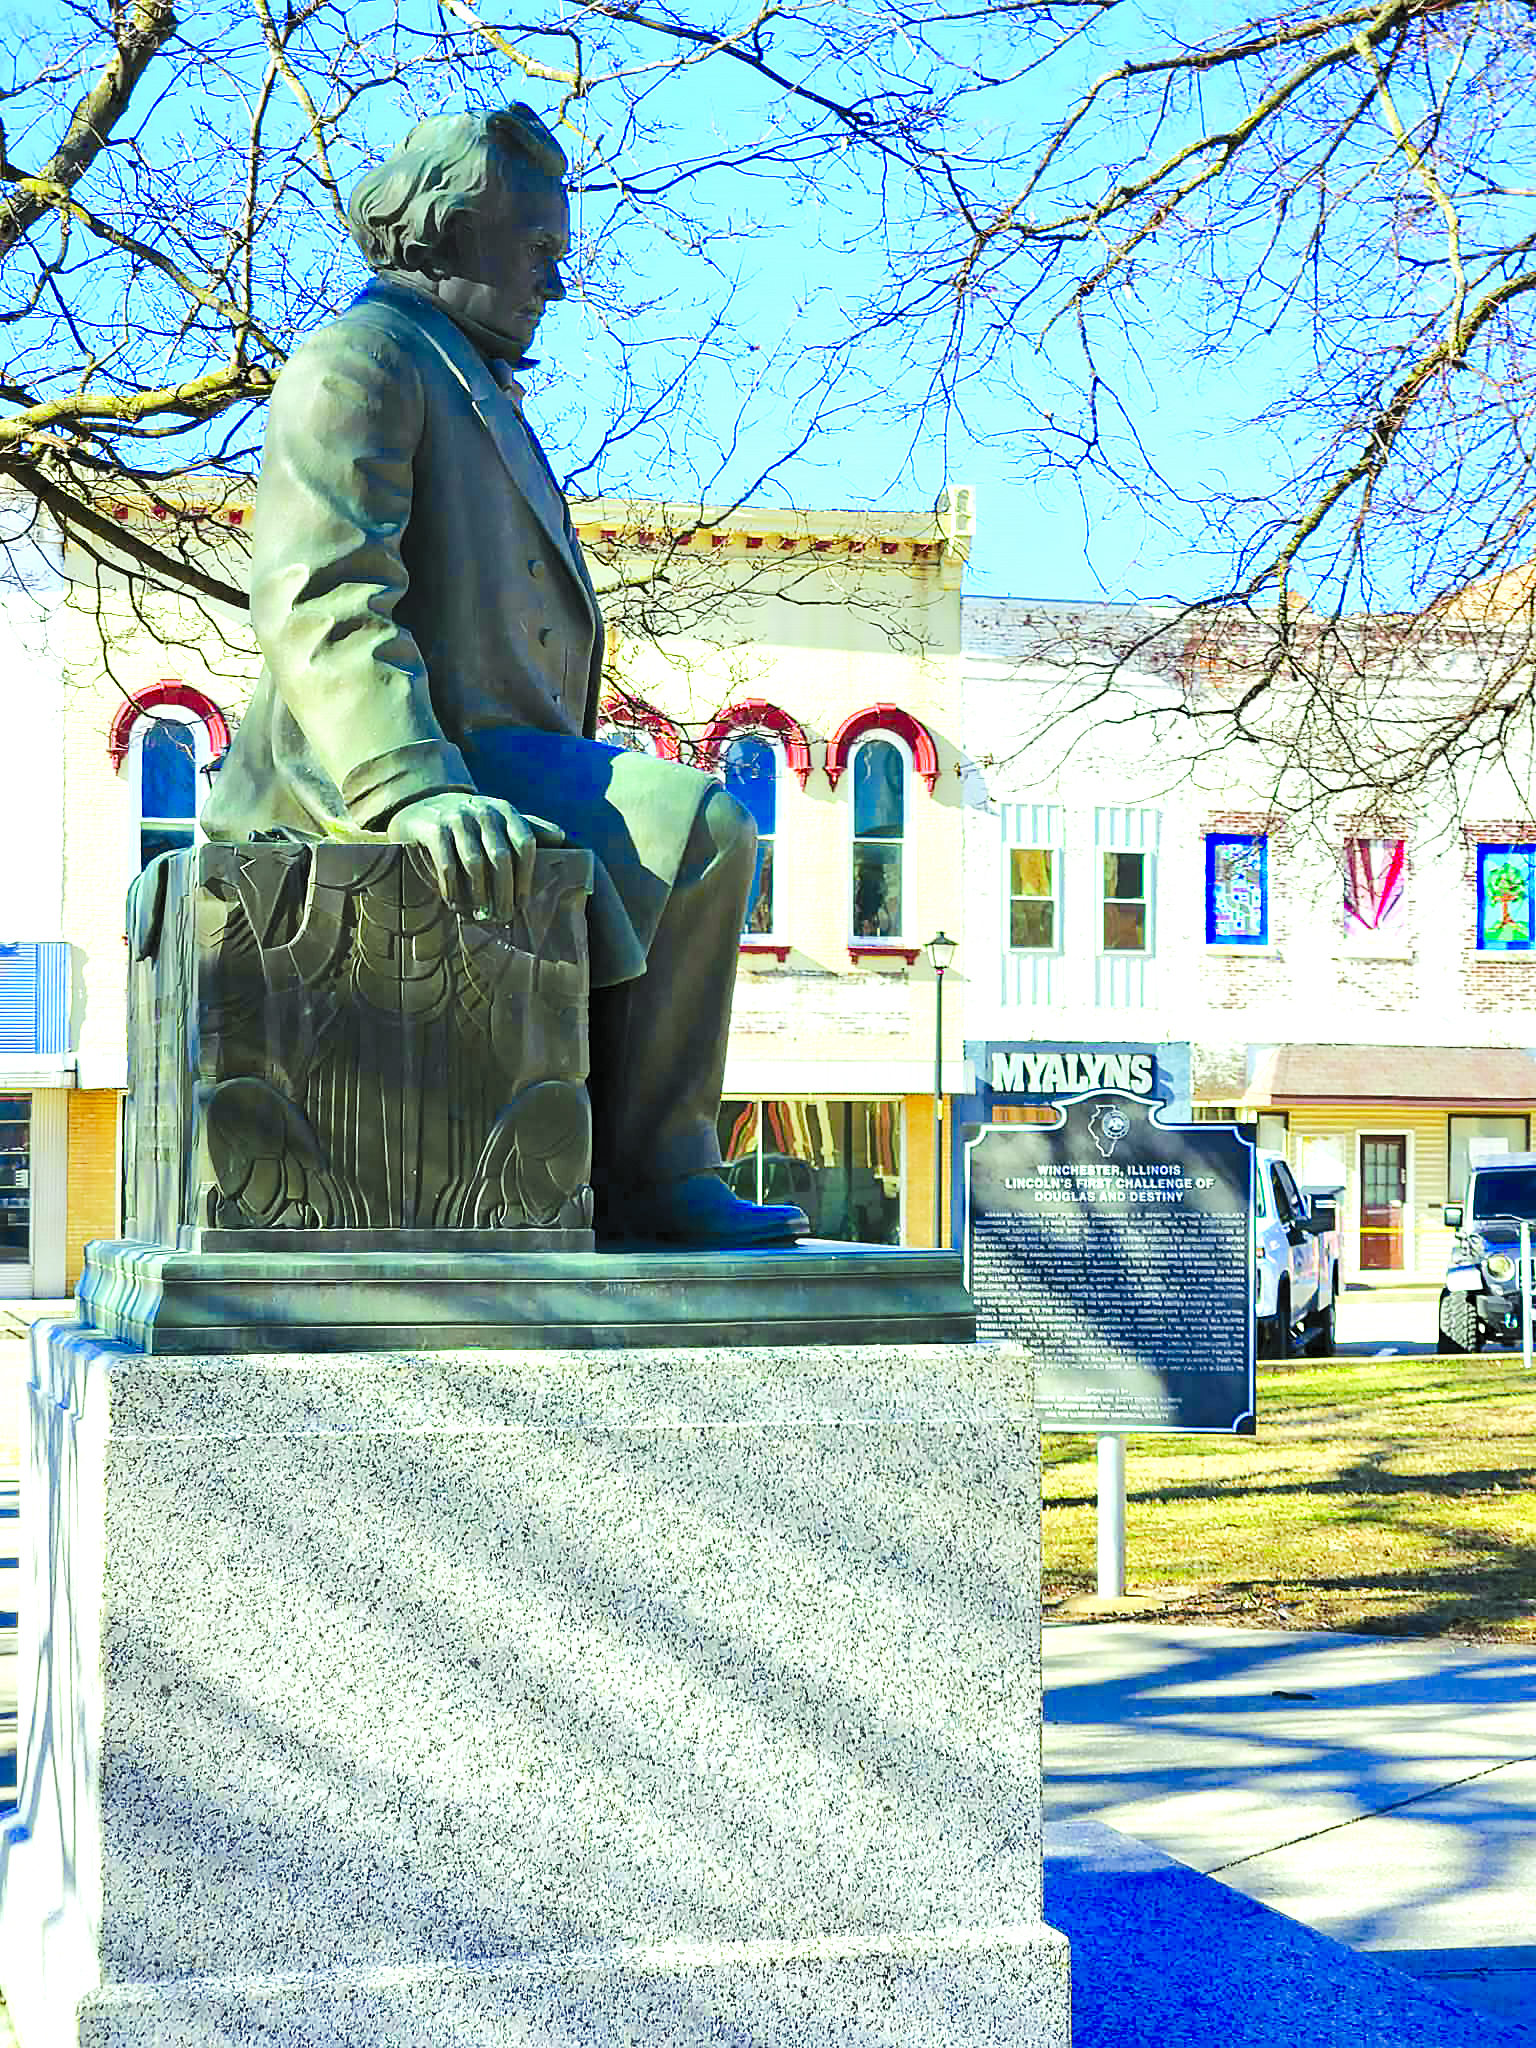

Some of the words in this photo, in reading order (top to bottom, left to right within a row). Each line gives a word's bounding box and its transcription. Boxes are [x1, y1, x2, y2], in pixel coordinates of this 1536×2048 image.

[992, 1053, 1153, 1094] MYALYNS
[1037, 1165, 1124, 1176] WINCHESTER,
[1127, 1165, 1181, 1176] ILLINOIS
[1005, 1178, 1072, 1189] LINCOLN'S
[1076, 1178, 1112, 1189] FIRST
[1115, 1178, 1193, 1189] CHALLENGE
[1195, 1177, 1216, 1189] OF
[1034, 1191, 1096, 1202] DOUGLAS
[1099, 1191, 1126, 1202] AND
[1129, 1191, 1184, 1202] DESTINY
